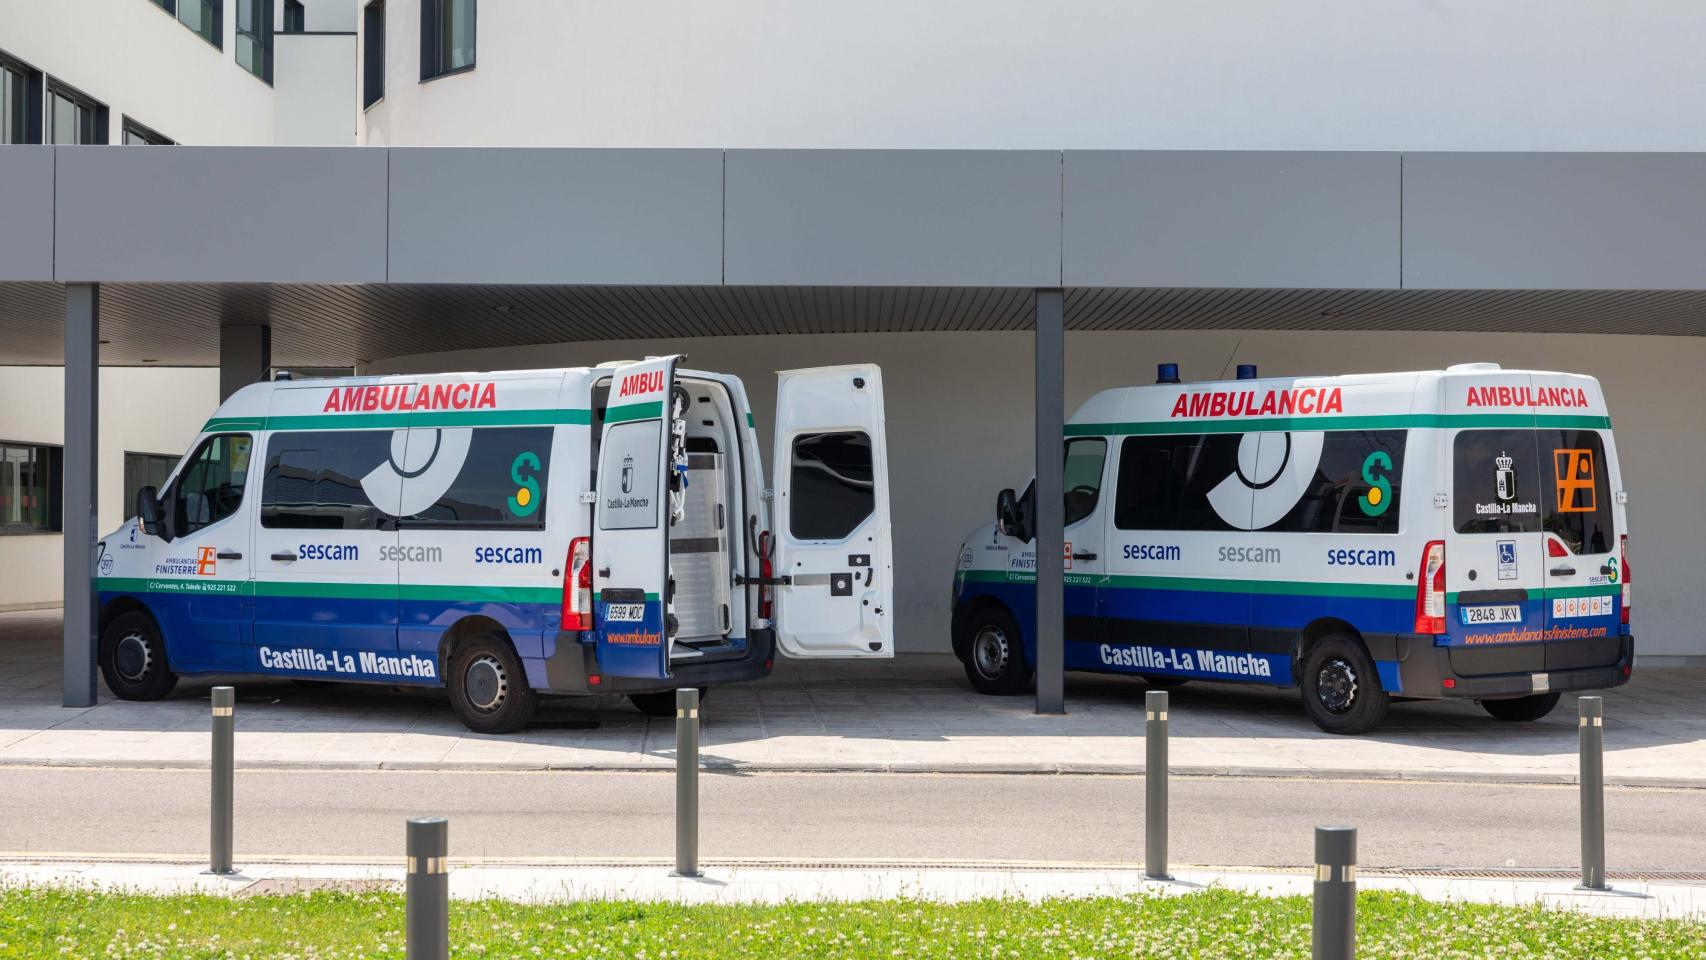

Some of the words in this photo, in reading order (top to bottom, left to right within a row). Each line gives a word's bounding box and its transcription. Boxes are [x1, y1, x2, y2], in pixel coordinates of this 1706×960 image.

[620, 371, 664, 397] AMBUL
[323, 383, 496, 412] AMBULANCIA
[1170, 388, 1343, 417] AMBULANCIA
[1467, 386, 1588, 407] AMBULANCIA
[630, 497, 649, 508] Mancha
[1475, 502, 1510, 514] Castilla-La
[1511, 502, 1537, 513] Mancha
[299, 544, 359, 560] sescam
[379, 545, 442, 562] sescam
[475, 546, 542, 564] sescam
[1123, 544, 1180, 560] sescam
[1218, 545, 1280, 563] sescam
[1328, 548, 1395, 566] sescam
[155, 565, 197, 574] FINISTERRE
[610, 606, 626, 619] 6599
[629, 606, 643, 619] MDC
[1470, 608, 1495, 622] 2848
[1499, 607, 1518, 620] JKV
[1465, 624, 1607, 645] www.ambulanciasfinisterre.com
[259, 646, 357, 673] Castilla-La
[358, 651, 436, 678] Mancha
[1100, 643, 1194, 671] Castilla-La
[1197, 650, 1271, 677] Mancha
